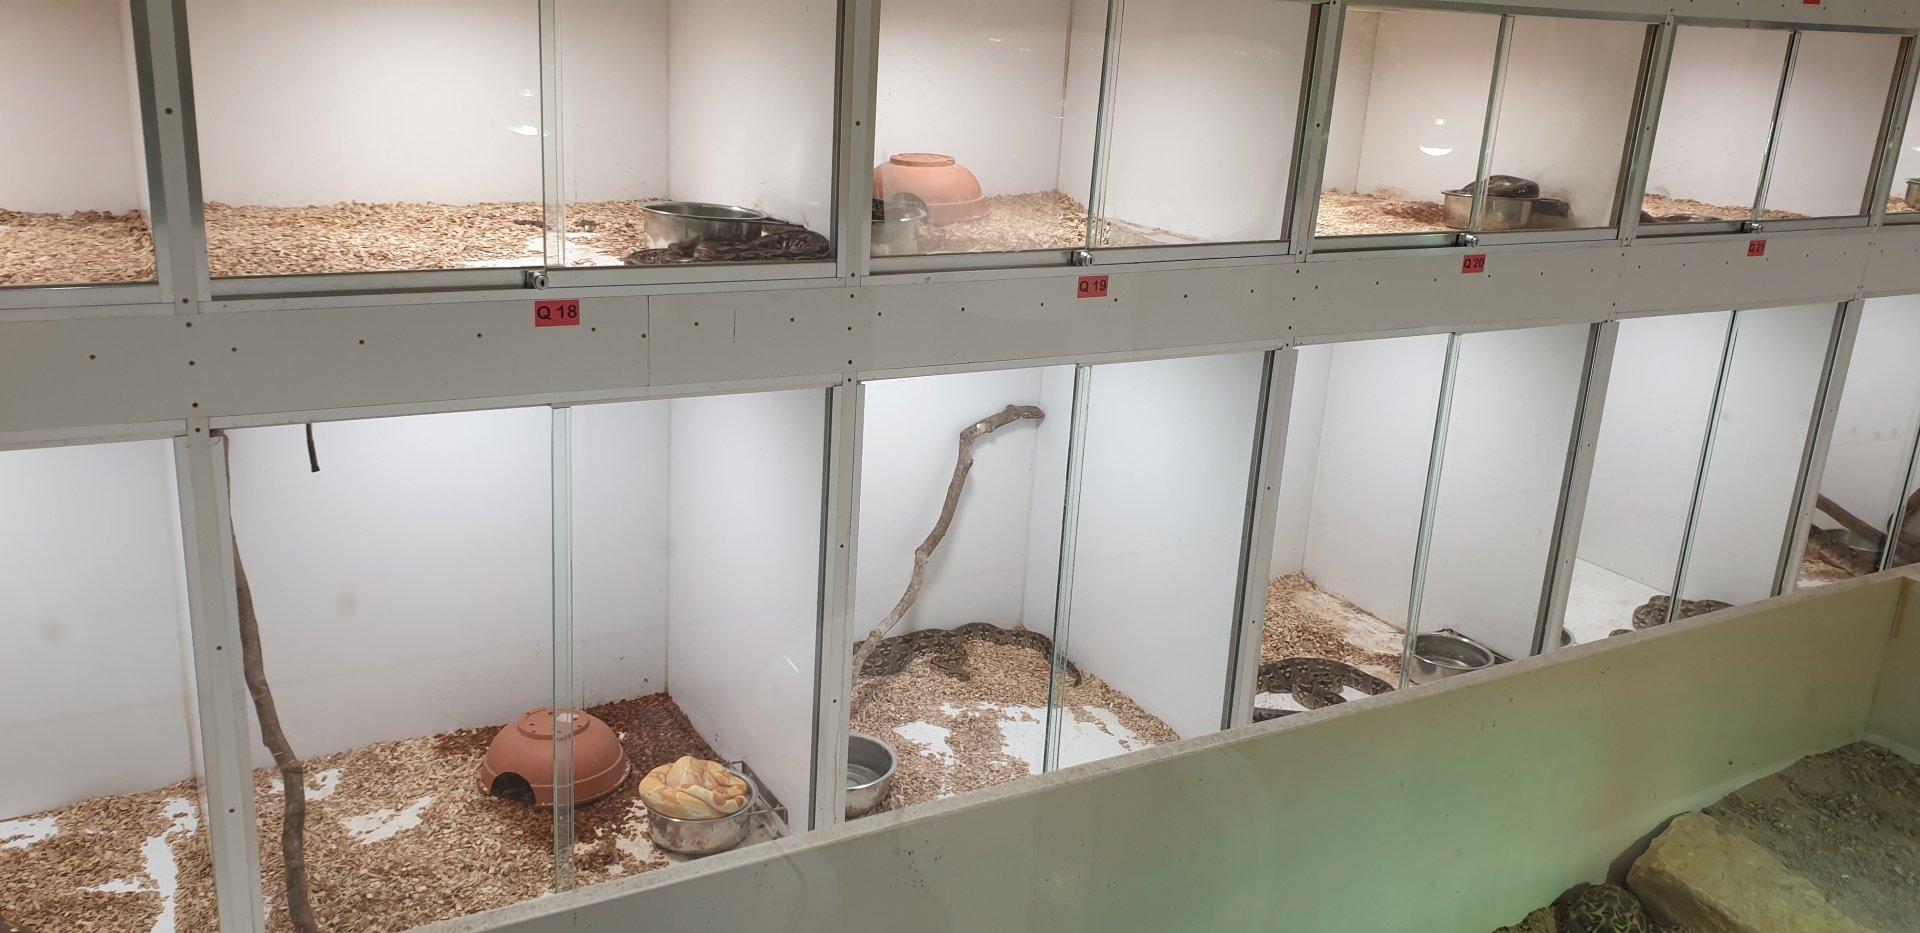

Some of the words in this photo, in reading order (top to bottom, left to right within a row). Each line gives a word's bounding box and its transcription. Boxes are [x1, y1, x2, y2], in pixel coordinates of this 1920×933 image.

[1464, 258, 1471, 268] Q
[1473, 257, 1484, 268] 20
[1080, 280, 1089, 292] Q
[1093, 279, 1107, 291] 19
[537, 305, 552, 320] Q
[556, 304, 577, 319] 18
